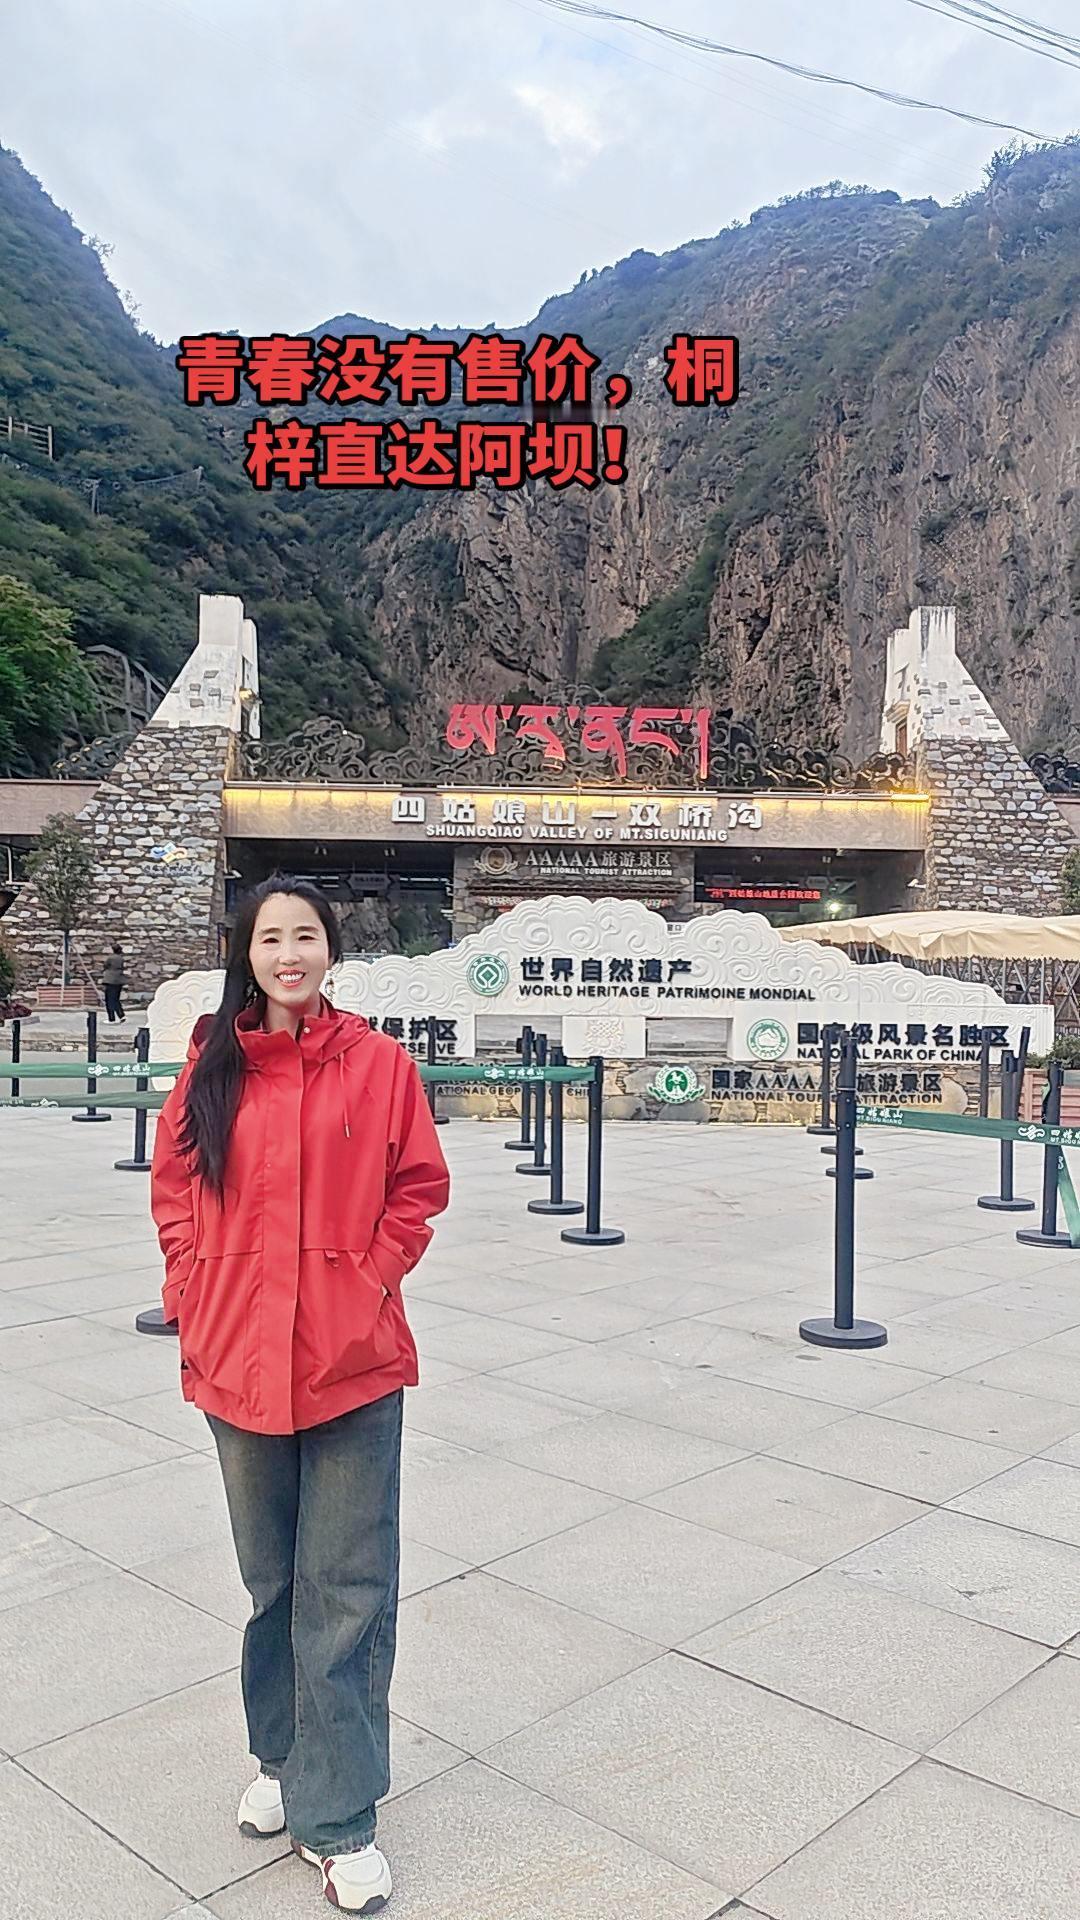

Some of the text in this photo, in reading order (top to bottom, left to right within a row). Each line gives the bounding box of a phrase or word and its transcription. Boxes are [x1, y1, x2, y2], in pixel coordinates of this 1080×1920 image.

[426, 824, 728, 842] SHUANGQIAO VALLEY OF MT.SIGUNIANG
[524, 849, 672, 868] AAAAA旅游景区
[540, 867, 673, 877] NATIONAL TOURIST ATTRACTION
[520, 957, 692, 983] 世界自然遗产
[518, 984, 816, 1001] WORLD HERITAGE PATRIMOINE MONDIAL
[797, 1047, 870, 1060] NATOL
[874, 1048, 913, 1060] PARK
[917, 1049, 936, 1061] OF
[437, 1086, 486, 1096] ATIONAL
[711, 1090, 784, 1101] NATIONAL
